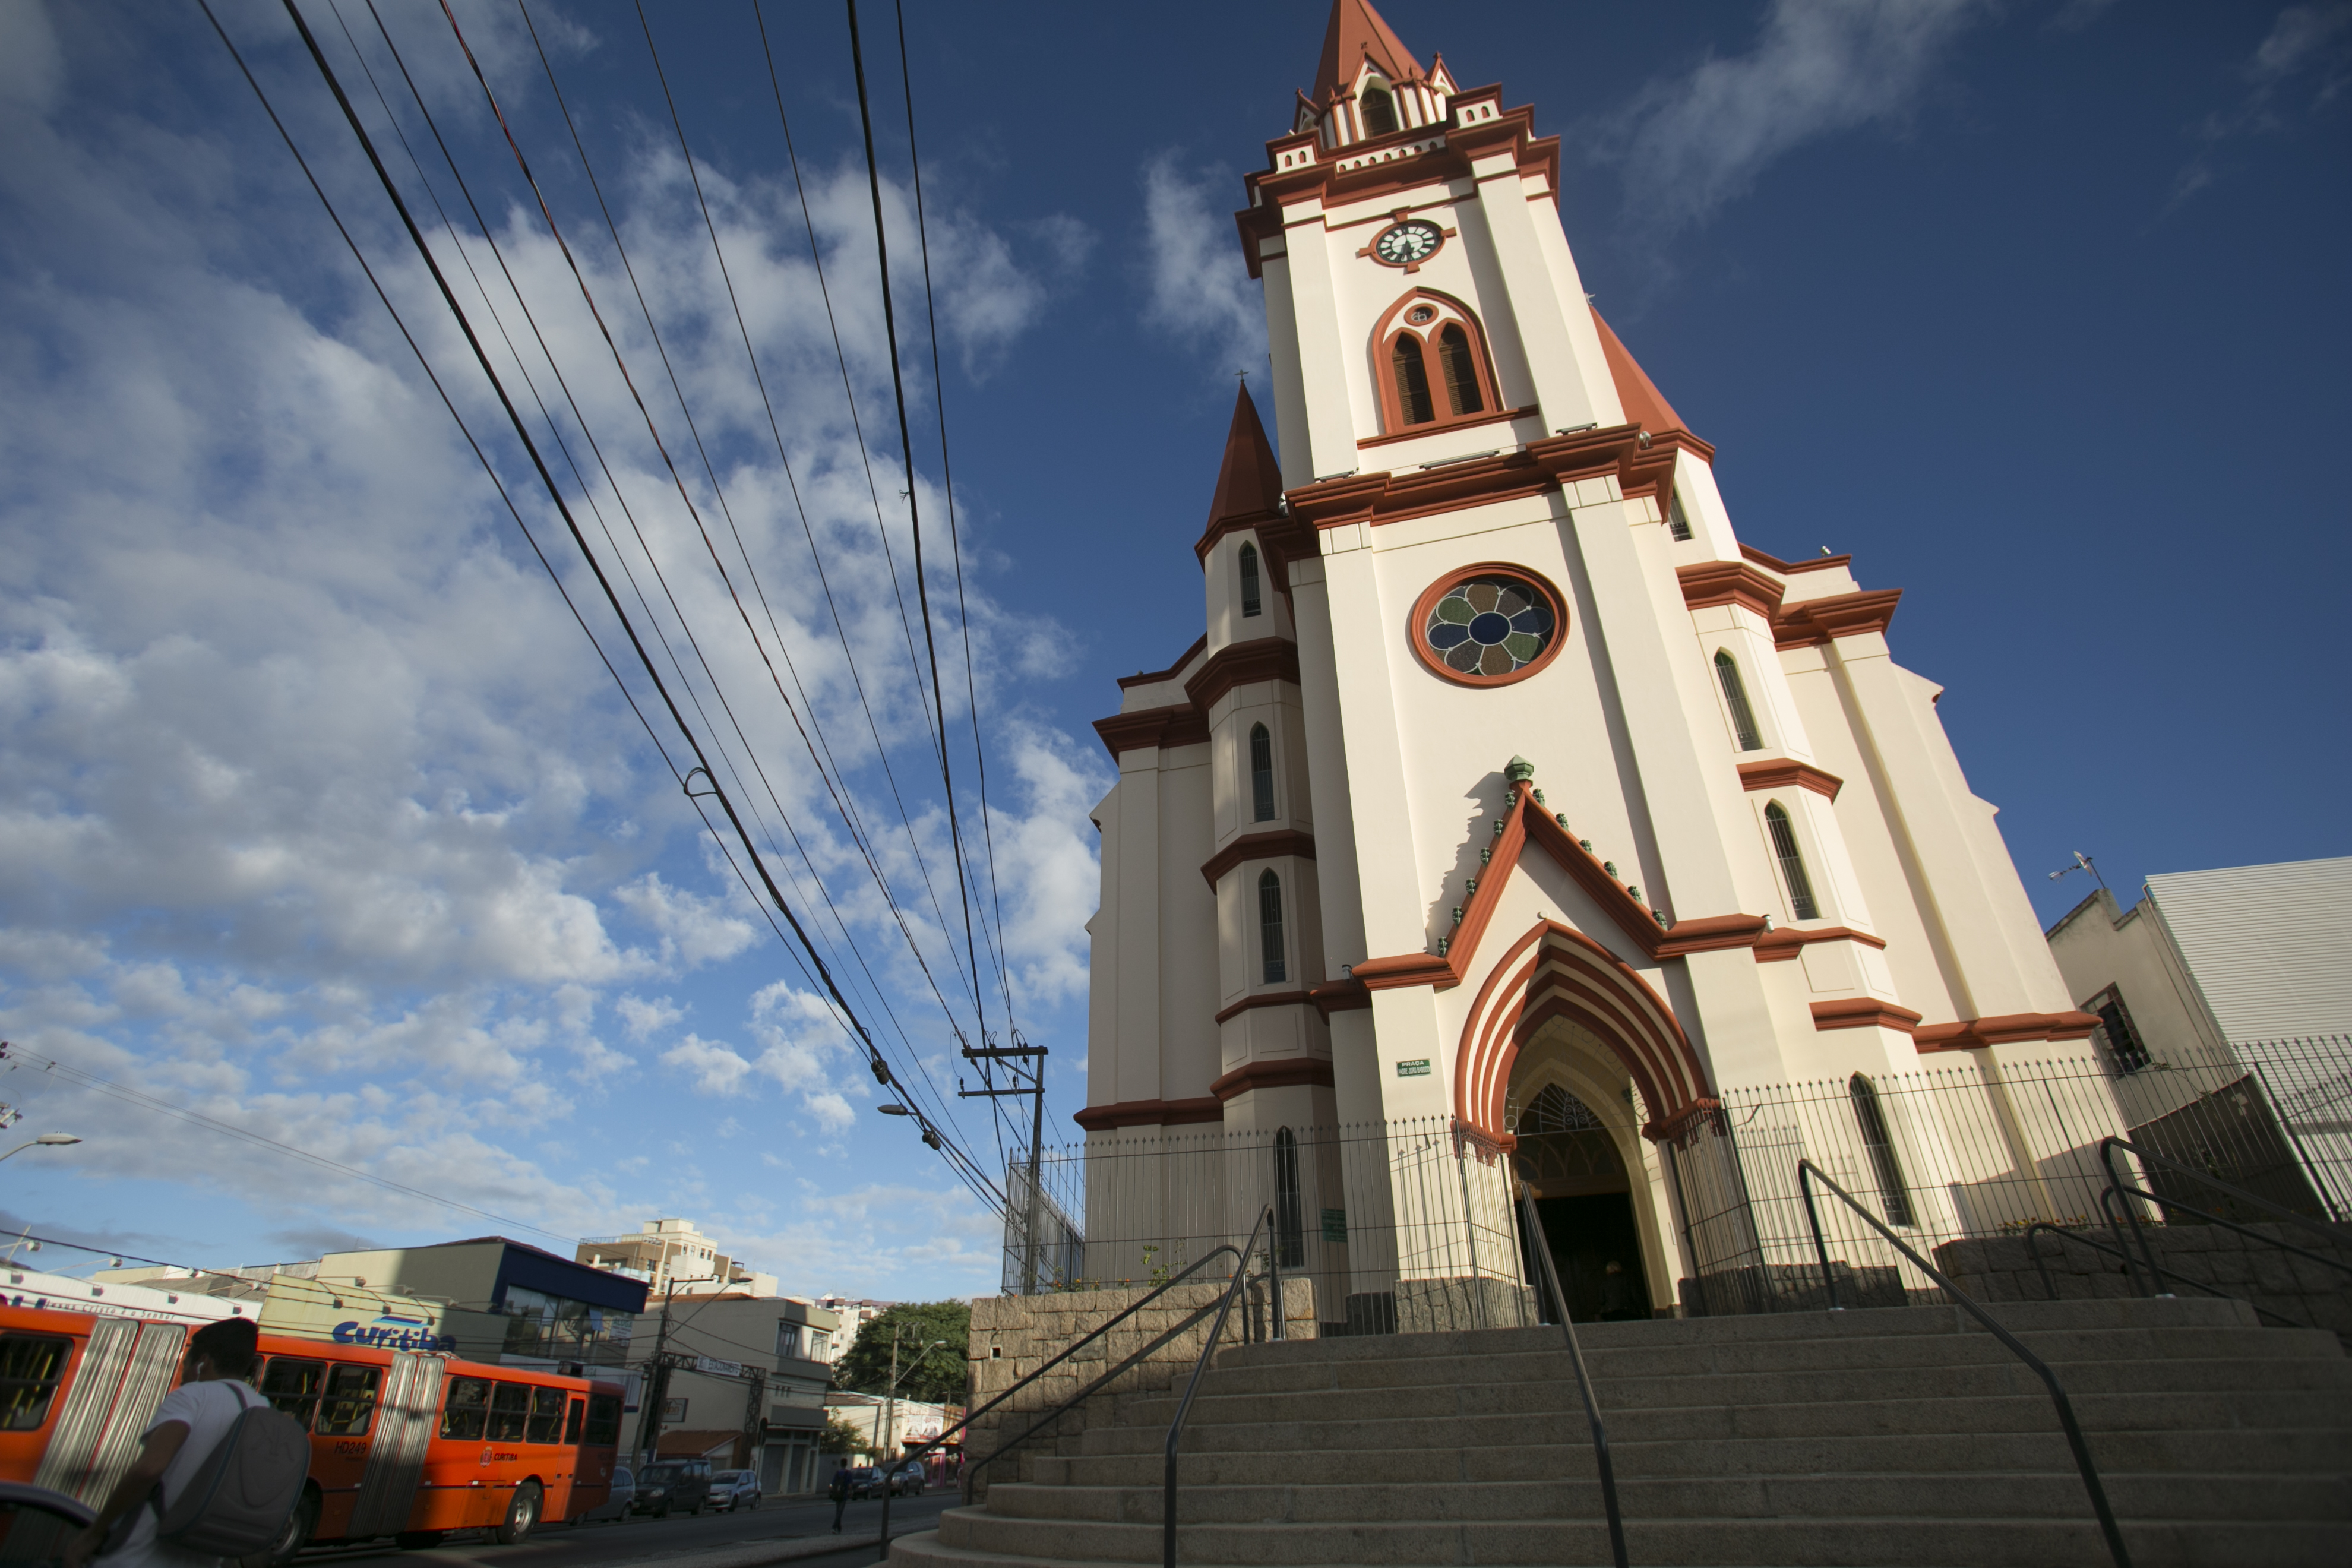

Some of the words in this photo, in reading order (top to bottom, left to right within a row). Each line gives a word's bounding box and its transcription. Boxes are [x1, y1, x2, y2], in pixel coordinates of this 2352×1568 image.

[45, 1300, 75, 1310] Jesus
[82, 1304, 116, 1314] Cristo
[141, 1310, 176, 1320] Senhor
[333, 1320, 457, 1352] Curitiba
[334, 1441, 367, 1454] HD249
[494, 1453, 518, 1462] CURITIBA
